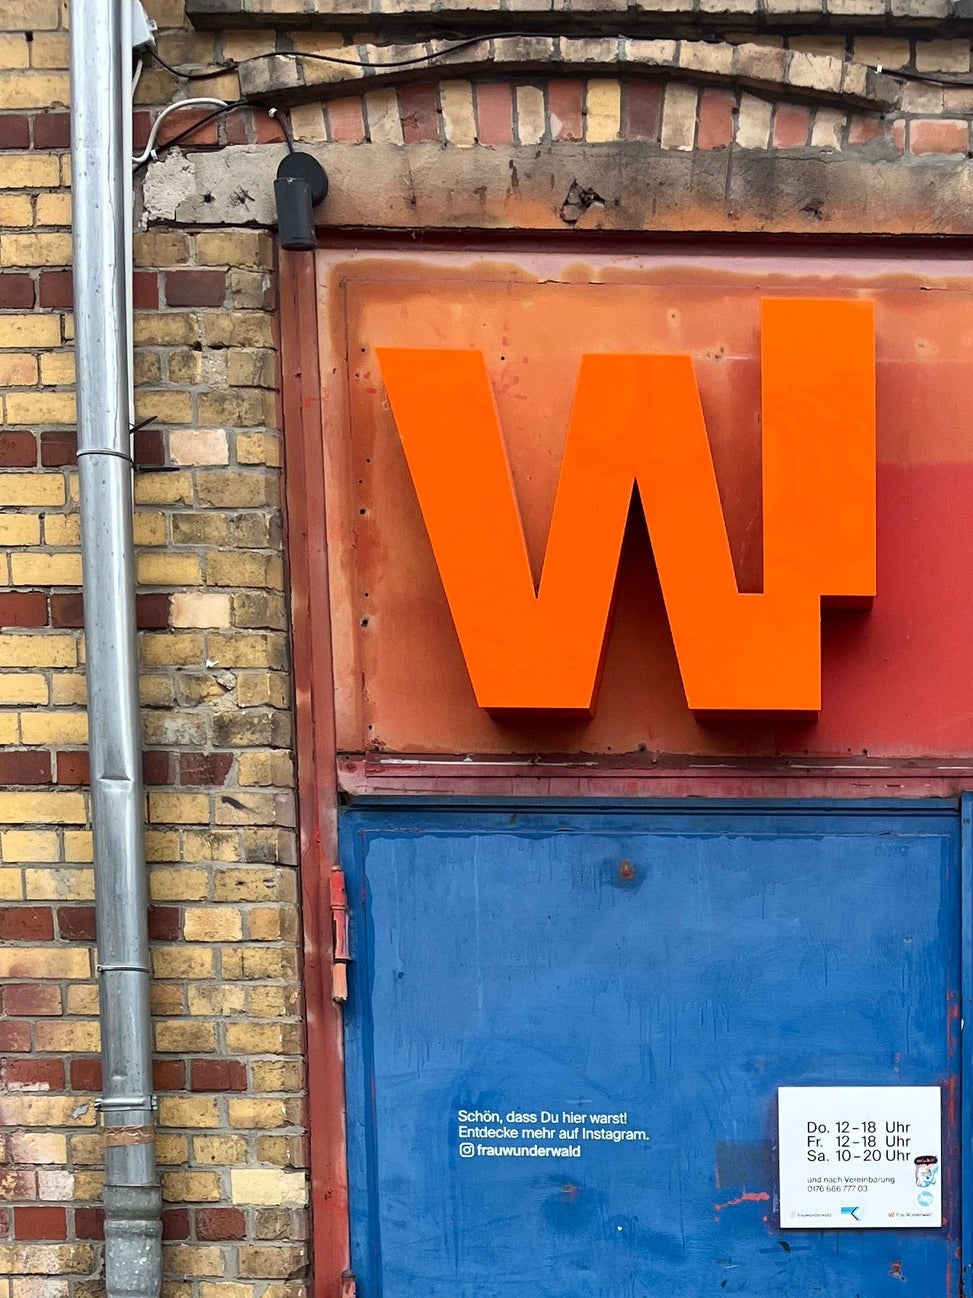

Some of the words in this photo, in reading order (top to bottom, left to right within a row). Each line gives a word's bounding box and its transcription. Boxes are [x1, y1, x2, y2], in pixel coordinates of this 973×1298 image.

[458, 1110, 503, 1124] Schön,
[506, 1111, 538, 1123] dass
[541, 1112, 559, 1123] Du
[562, 1112, 587, 1124] hier
[590, 1113, 628, 1125] warst!
[807, 1121, 830, 1133] Do.
[885, 1121, 911, 1133] Uhr
[458, 1126, 519, 1139] Entdecke
[522, 1127, 555, 1139] mehr
[559, 1128, 579, 1140] auf
[582, 1128, 650, 1142] Instagram.
[807, 1135, 824, 1147] Fr.
[885, 1135, 911, 1147] Uhr
[477, 1144, 581, 1158] frauwunderwald
[807, 1149, 830, 1161] Sa.
[885, 1149, 911, 1161] Uhr
[844, 1176, 896, 1185] Vereinbarung
